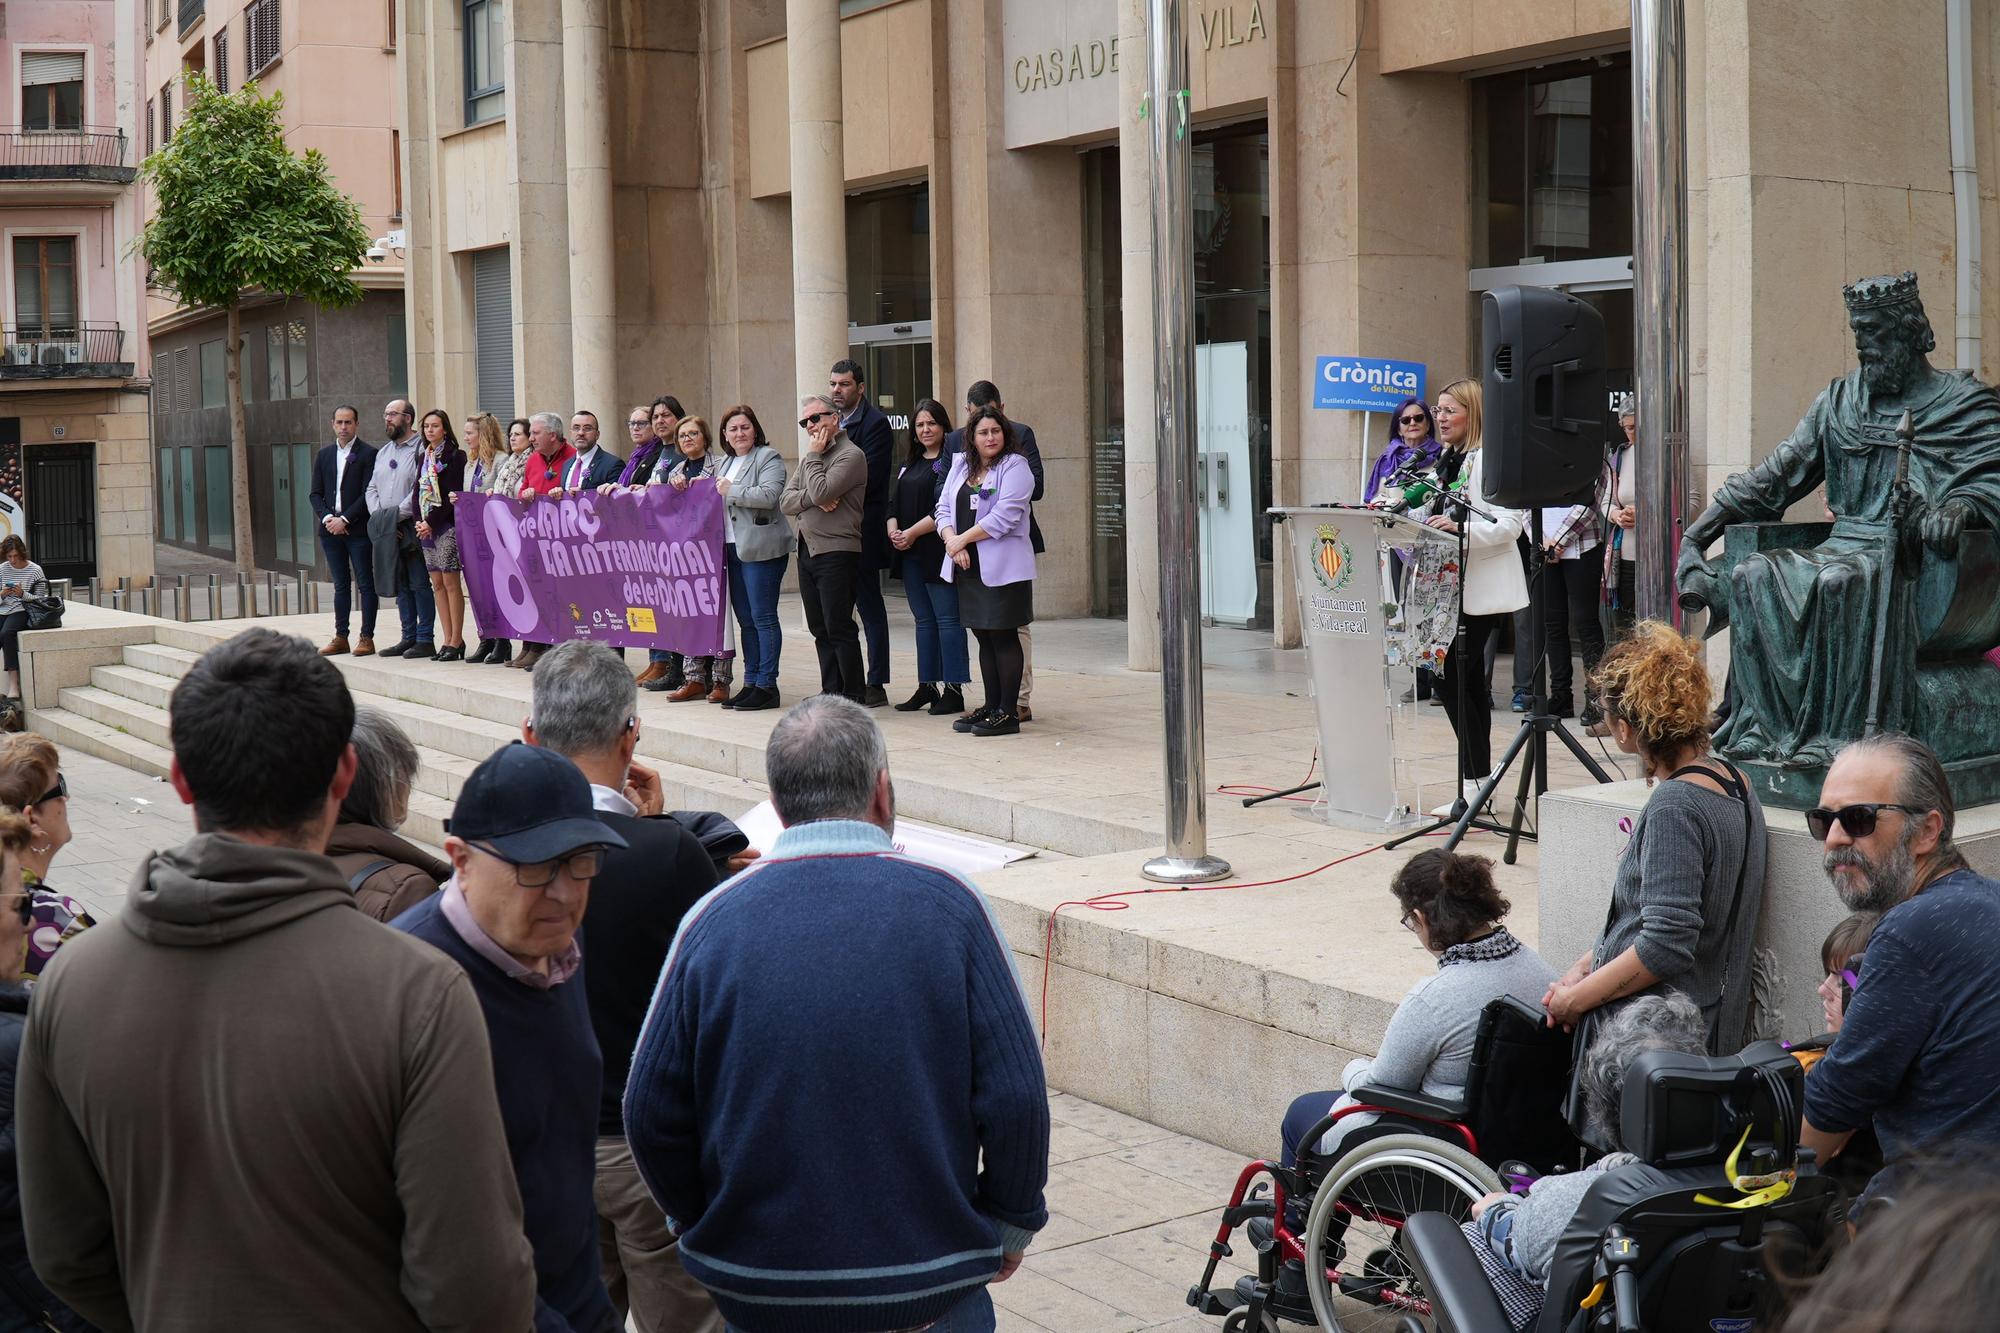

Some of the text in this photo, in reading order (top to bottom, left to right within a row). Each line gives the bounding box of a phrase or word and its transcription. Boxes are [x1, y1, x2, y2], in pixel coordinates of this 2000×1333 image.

[1199, 0, 1267, 50] VILA
[1323, 361, 1418, 388] Crònica
[1370, 384, 1417, 396] de Vila-real
[887, 415, 910, 430] XIDA
[483, 498, 600, 634] 8 de MARÇ
[1311, 593, 1367, 612] Ajuntament
[1318, 613, 1369, 634] Vila-real
